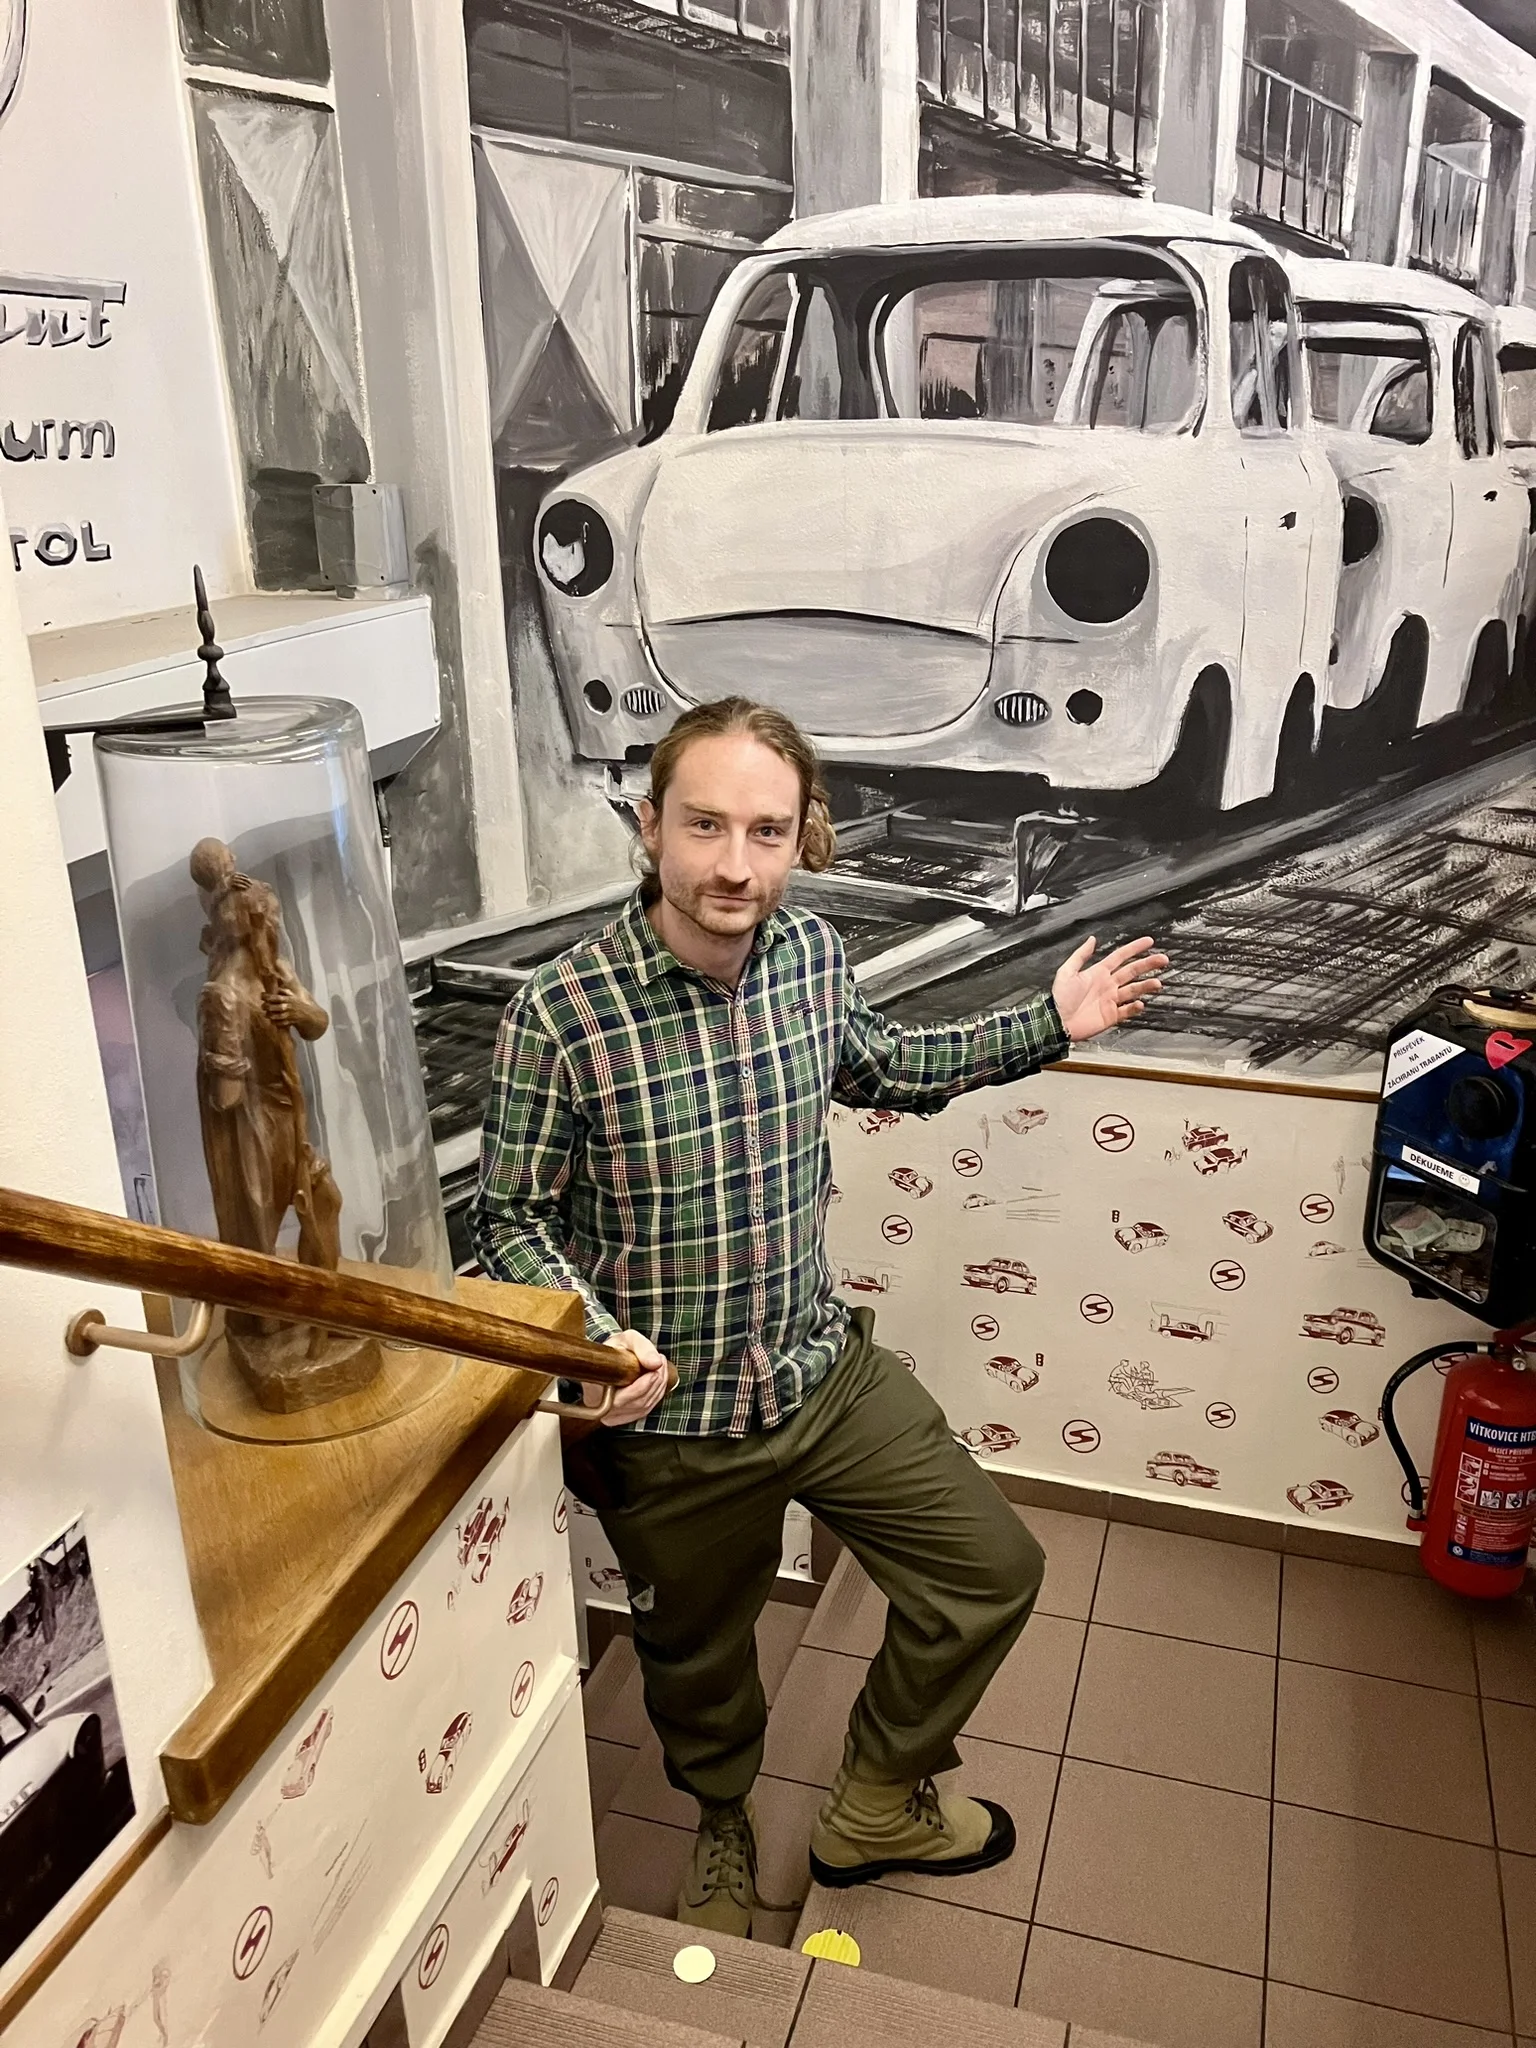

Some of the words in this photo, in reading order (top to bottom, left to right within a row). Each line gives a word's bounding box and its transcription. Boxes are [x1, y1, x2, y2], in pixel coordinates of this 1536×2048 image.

[1408, 1053, 1420, 1062] NA
[1410, 1153, 1455, 1180] DĚKUJEME
[1470, 1421, 1519, 1442] VÍTKOVICE
